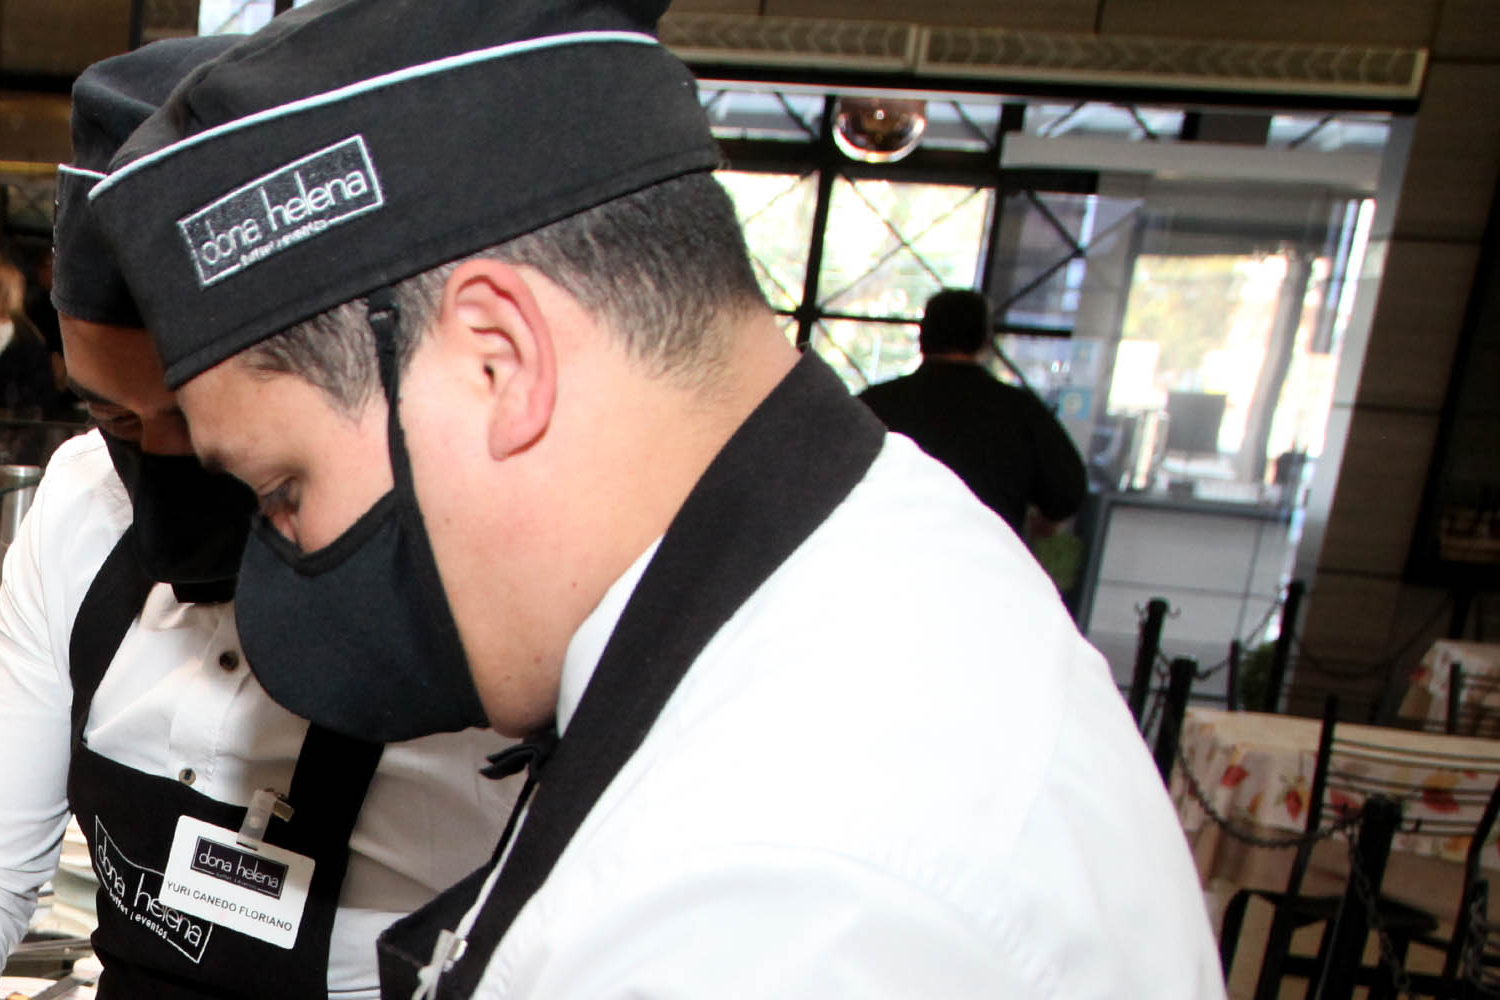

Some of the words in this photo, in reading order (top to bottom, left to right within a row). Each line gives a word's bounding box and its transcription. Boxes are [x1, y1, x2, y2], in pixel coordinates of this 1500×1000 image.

[201, 219, 263, 266] dona
[259, 170, 368, 232] helena
[98, 836, 125, 898] dona
[199, 844, 232, 873] dona
[235, 855, 279, 889] helena
[167, 881, 191, 896] YURI
[192, 889, 237, 912] CANEDO
[238, 905, 293, 932] FLORIANO
